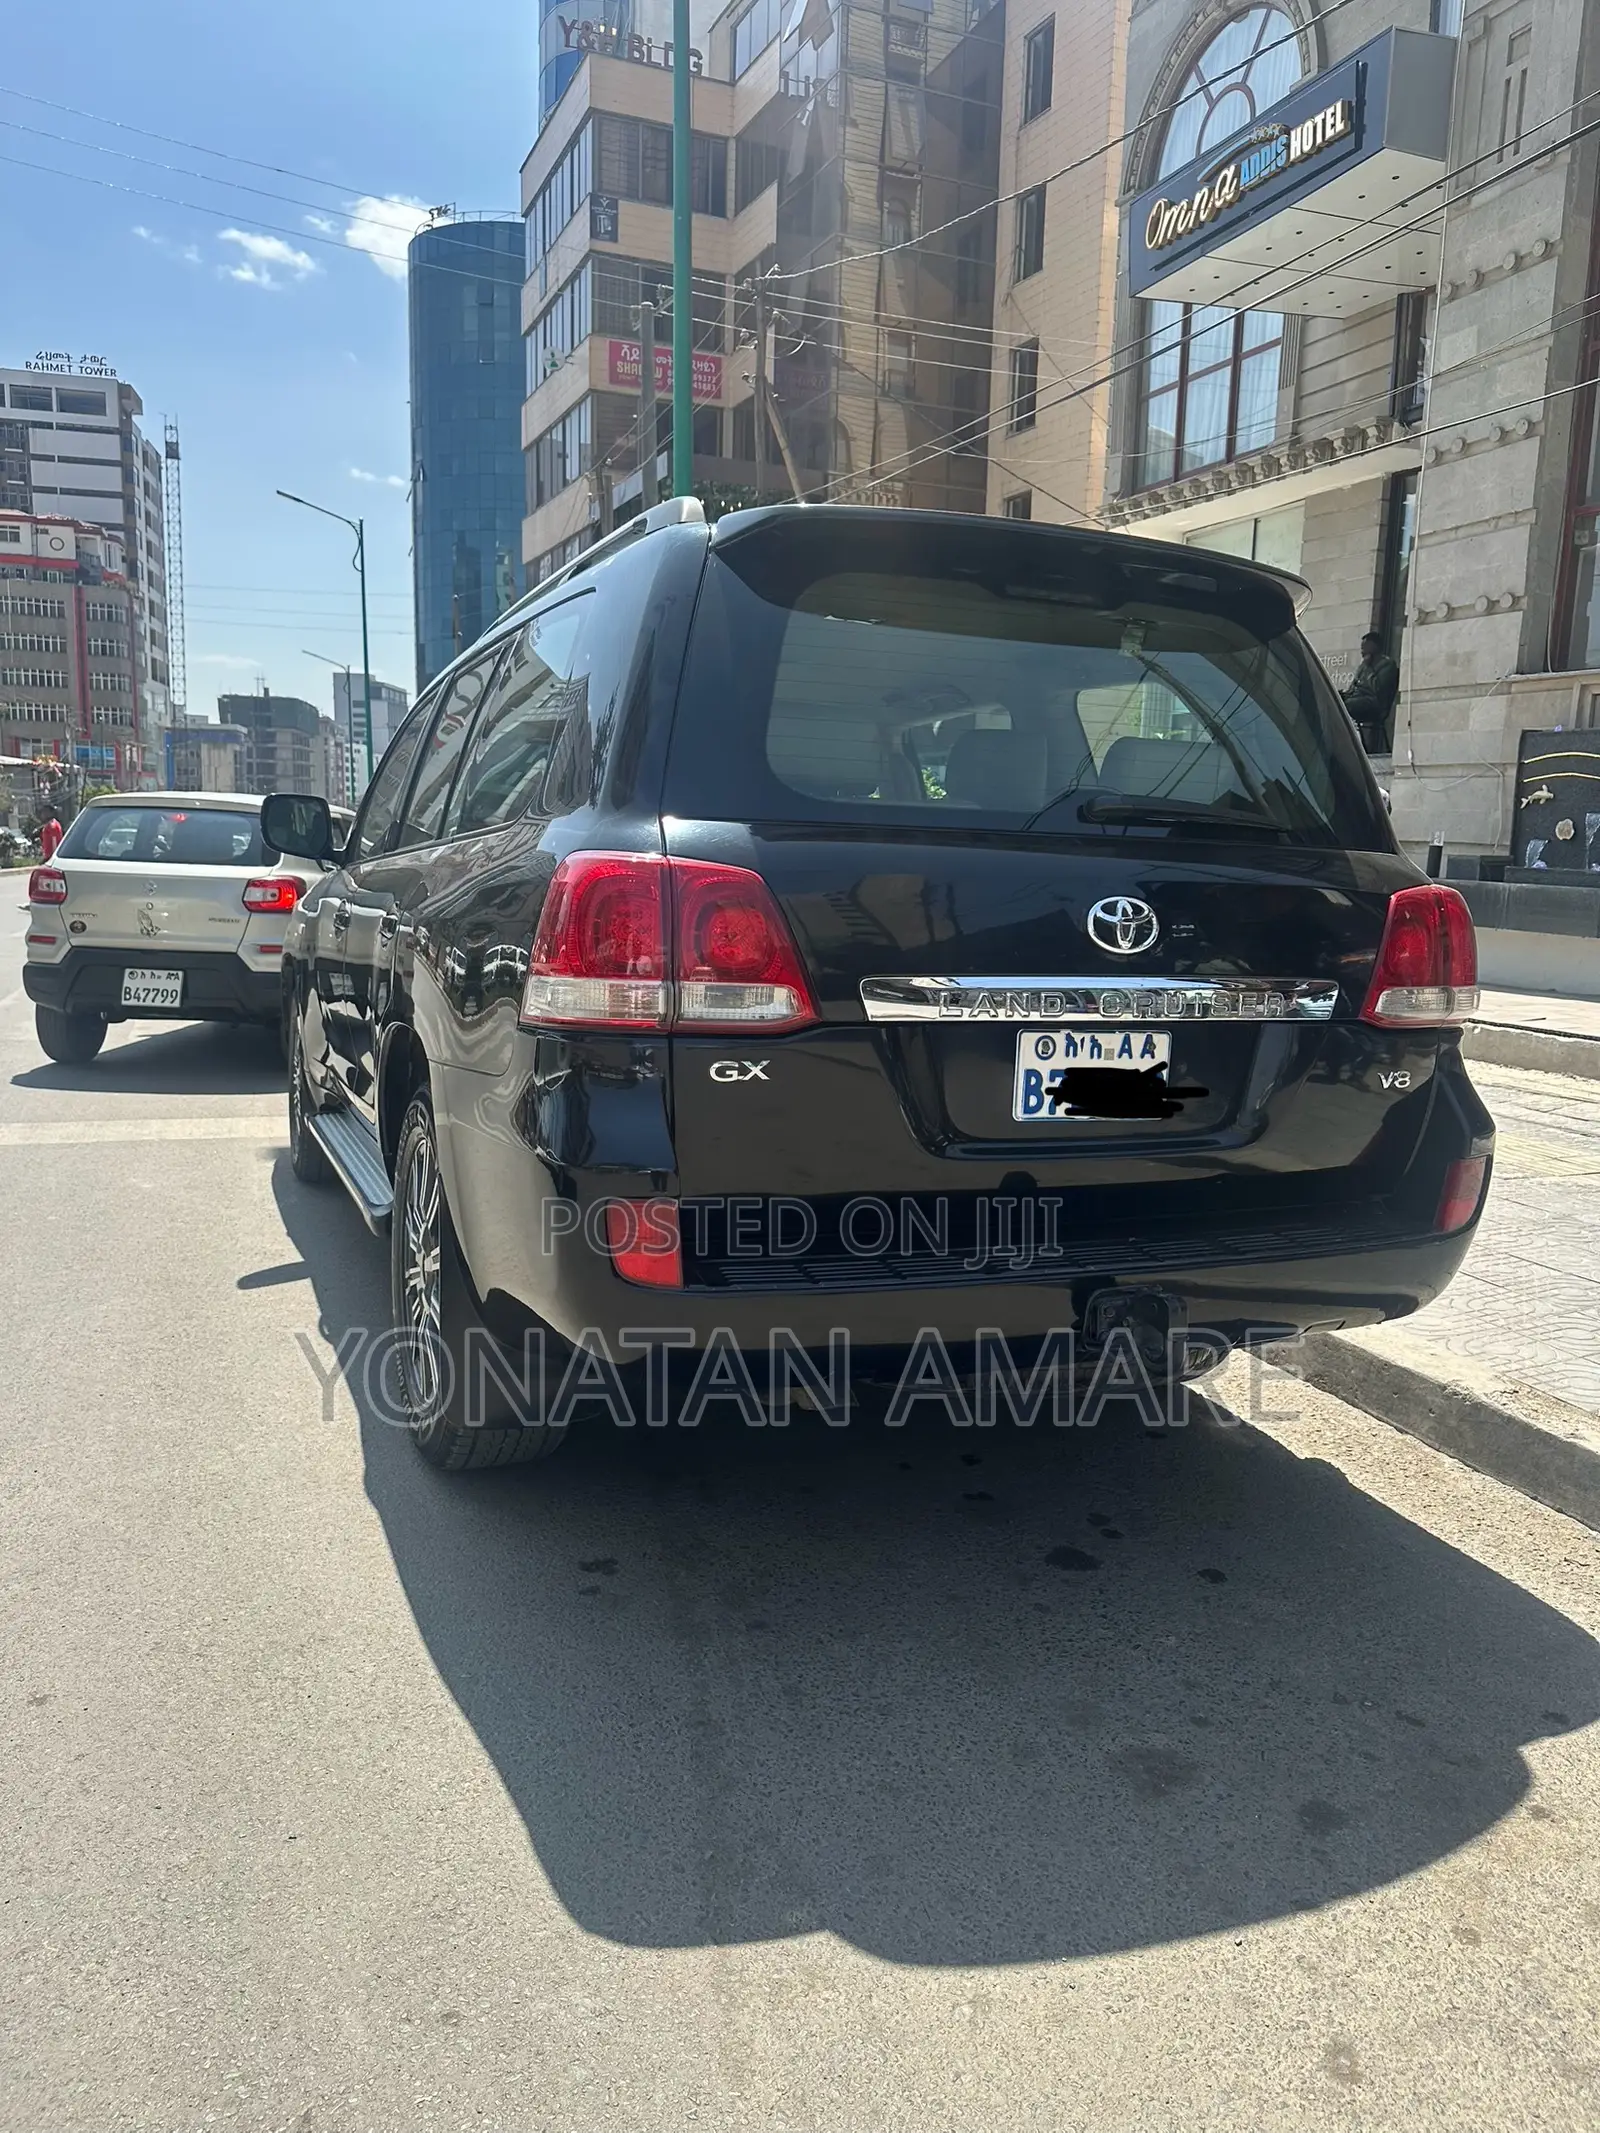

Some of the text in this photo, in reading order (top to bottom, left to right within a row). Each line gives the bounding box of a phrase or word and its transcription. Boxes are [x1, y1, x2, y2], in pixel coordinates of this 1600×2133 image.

[1289, 98, 1346, 163] HOTEL
[25, 360, 117, 377] RAHMET TOWER
[123, 986, 179, 1005] B47799
[938, 990, 1286, 1018] LAND CRUISER
[1117, 1033, 1157, 1060] AA
[709, 1060, 771, 1082] GX
[1377, 1070, 1411, 1089] V8
